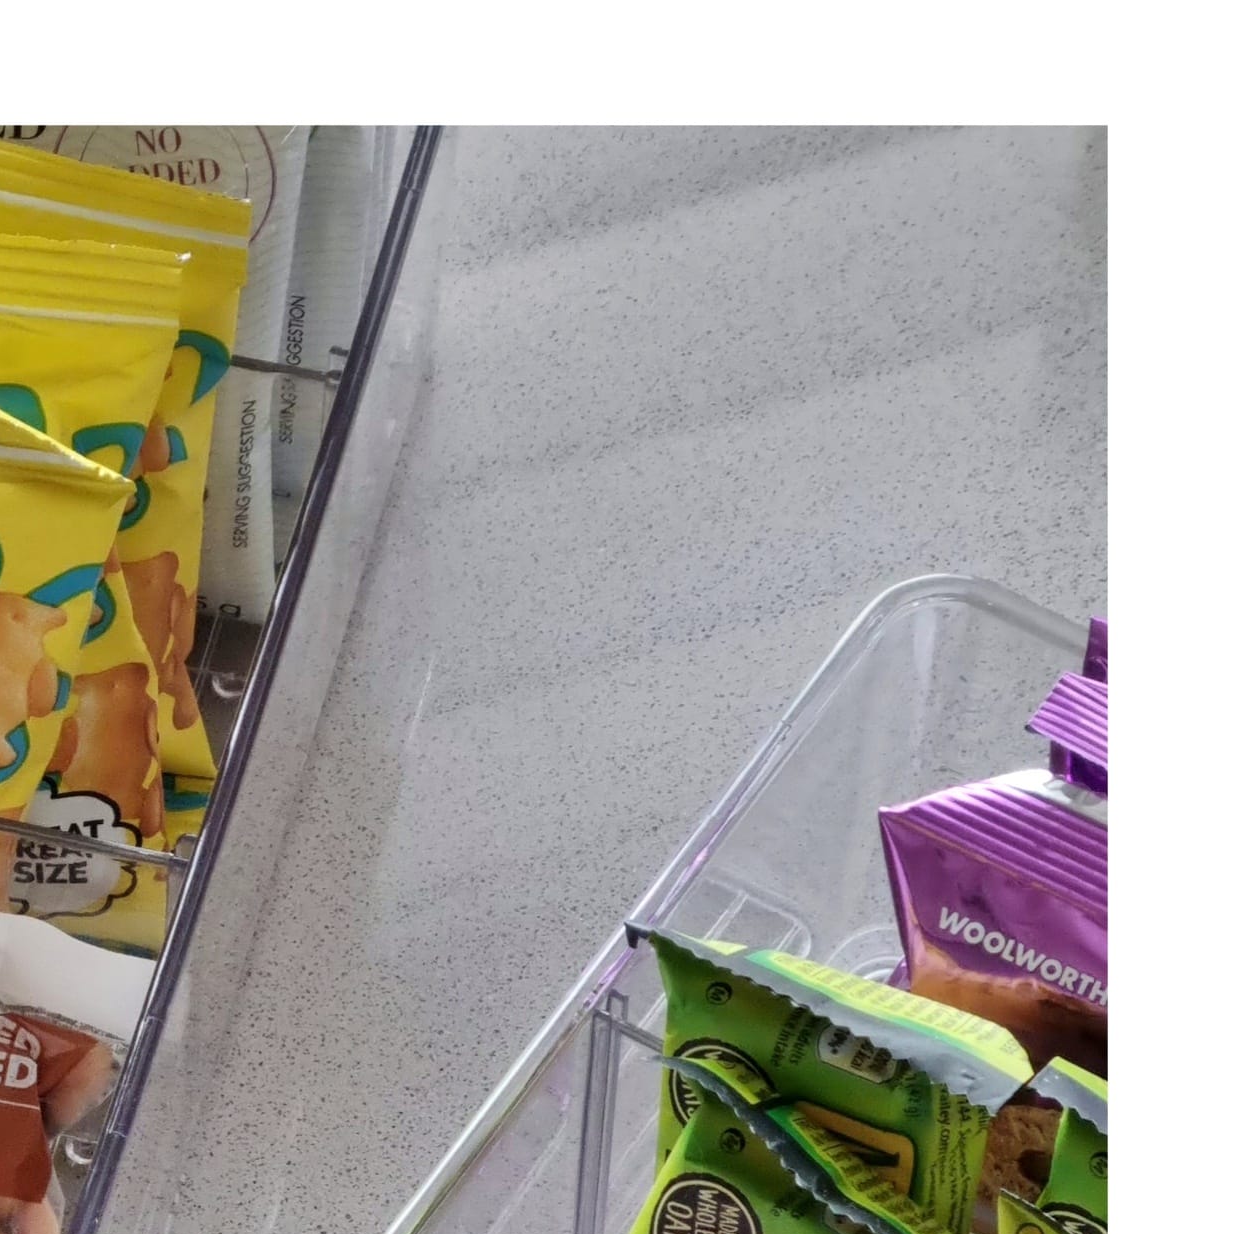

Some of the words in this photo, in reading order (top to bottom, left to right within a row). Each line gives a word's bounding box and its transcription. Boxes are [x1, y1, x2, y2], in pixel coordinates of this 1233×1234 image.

[135, 127, 182, 157] NO
[284, 295, 307, 368] GGESTION
[237, 400, 256, 494] SUGGESTION
[233, 496, 251, 549] SERVING
[14, 861, 88, 884] SIZE
